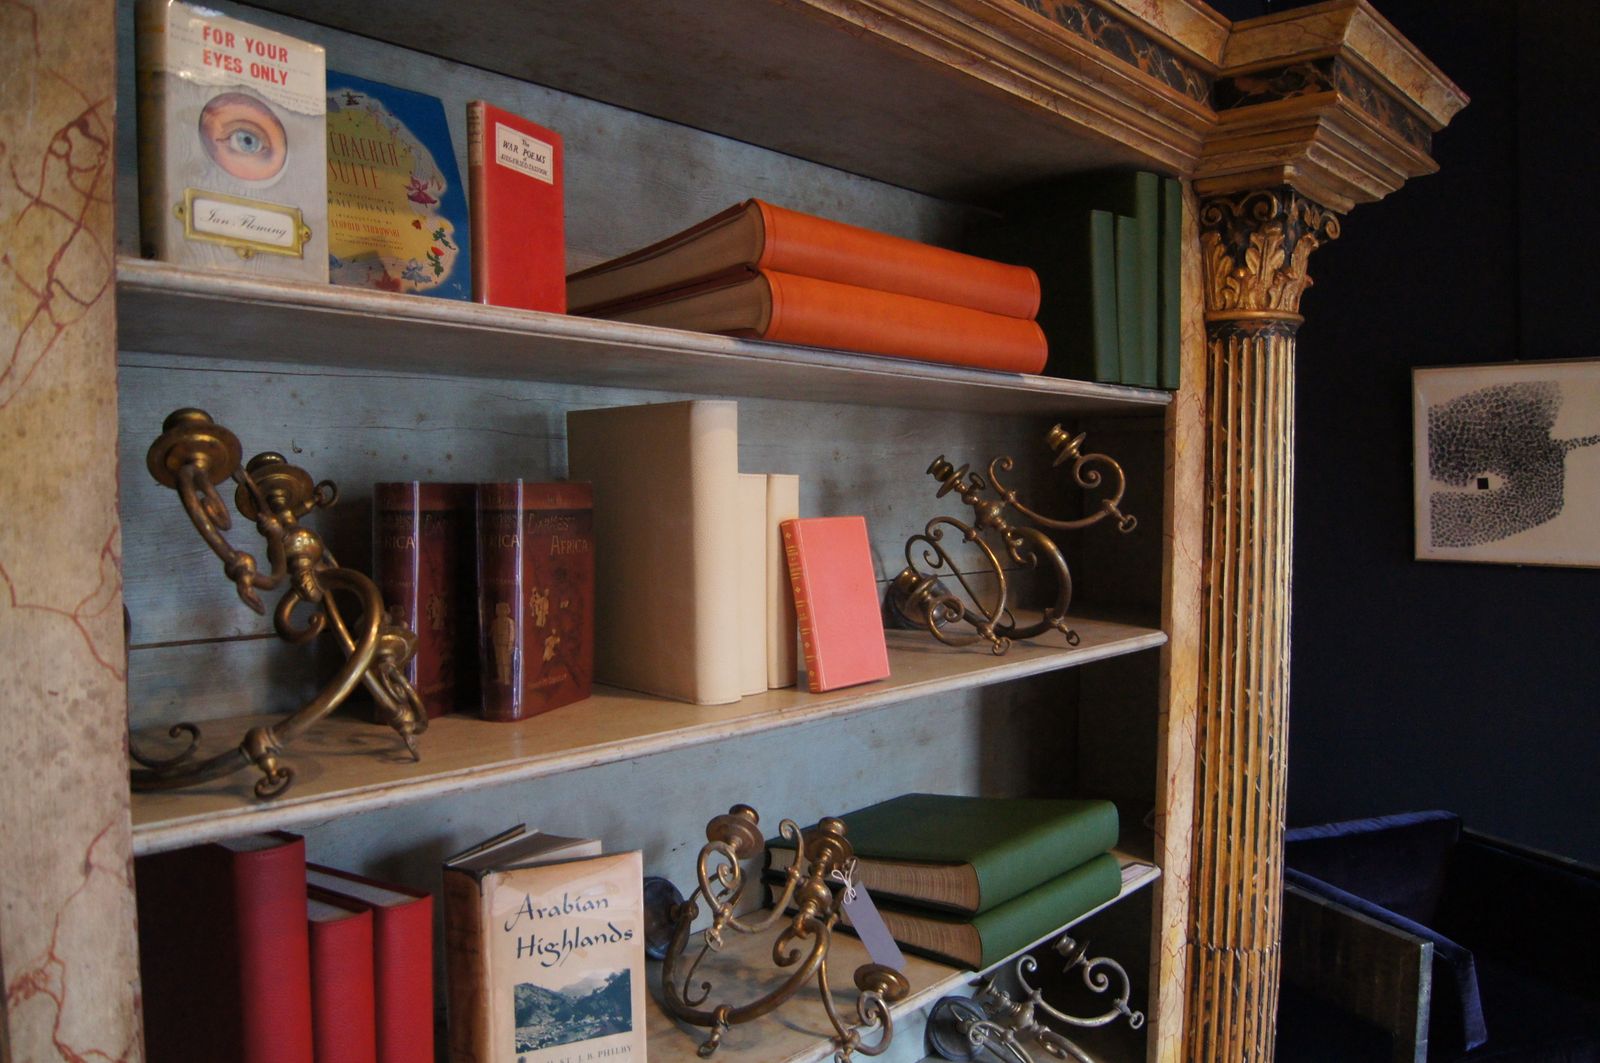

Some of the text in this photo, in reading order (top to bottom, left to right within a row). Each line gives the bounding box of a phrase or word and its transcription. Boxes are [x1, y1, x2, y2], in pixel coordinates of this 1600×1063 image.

[202, 24, 236, 48] FOR
[245, 35, 289, 63] YOUR
[202, 48, 289, 86] EYES ONLY
[502, 140, 547, 164] WAR POEMS
[522, 139, 530, 148] The
[327, 158, 380, 190] SUITE
[204, 208, 288, 241] Ian Fleming
[550, 534, 589, 557] AFRICA
[504, 892, 609, 932] Arabian
[516, 921, 634, 967] Highlands
